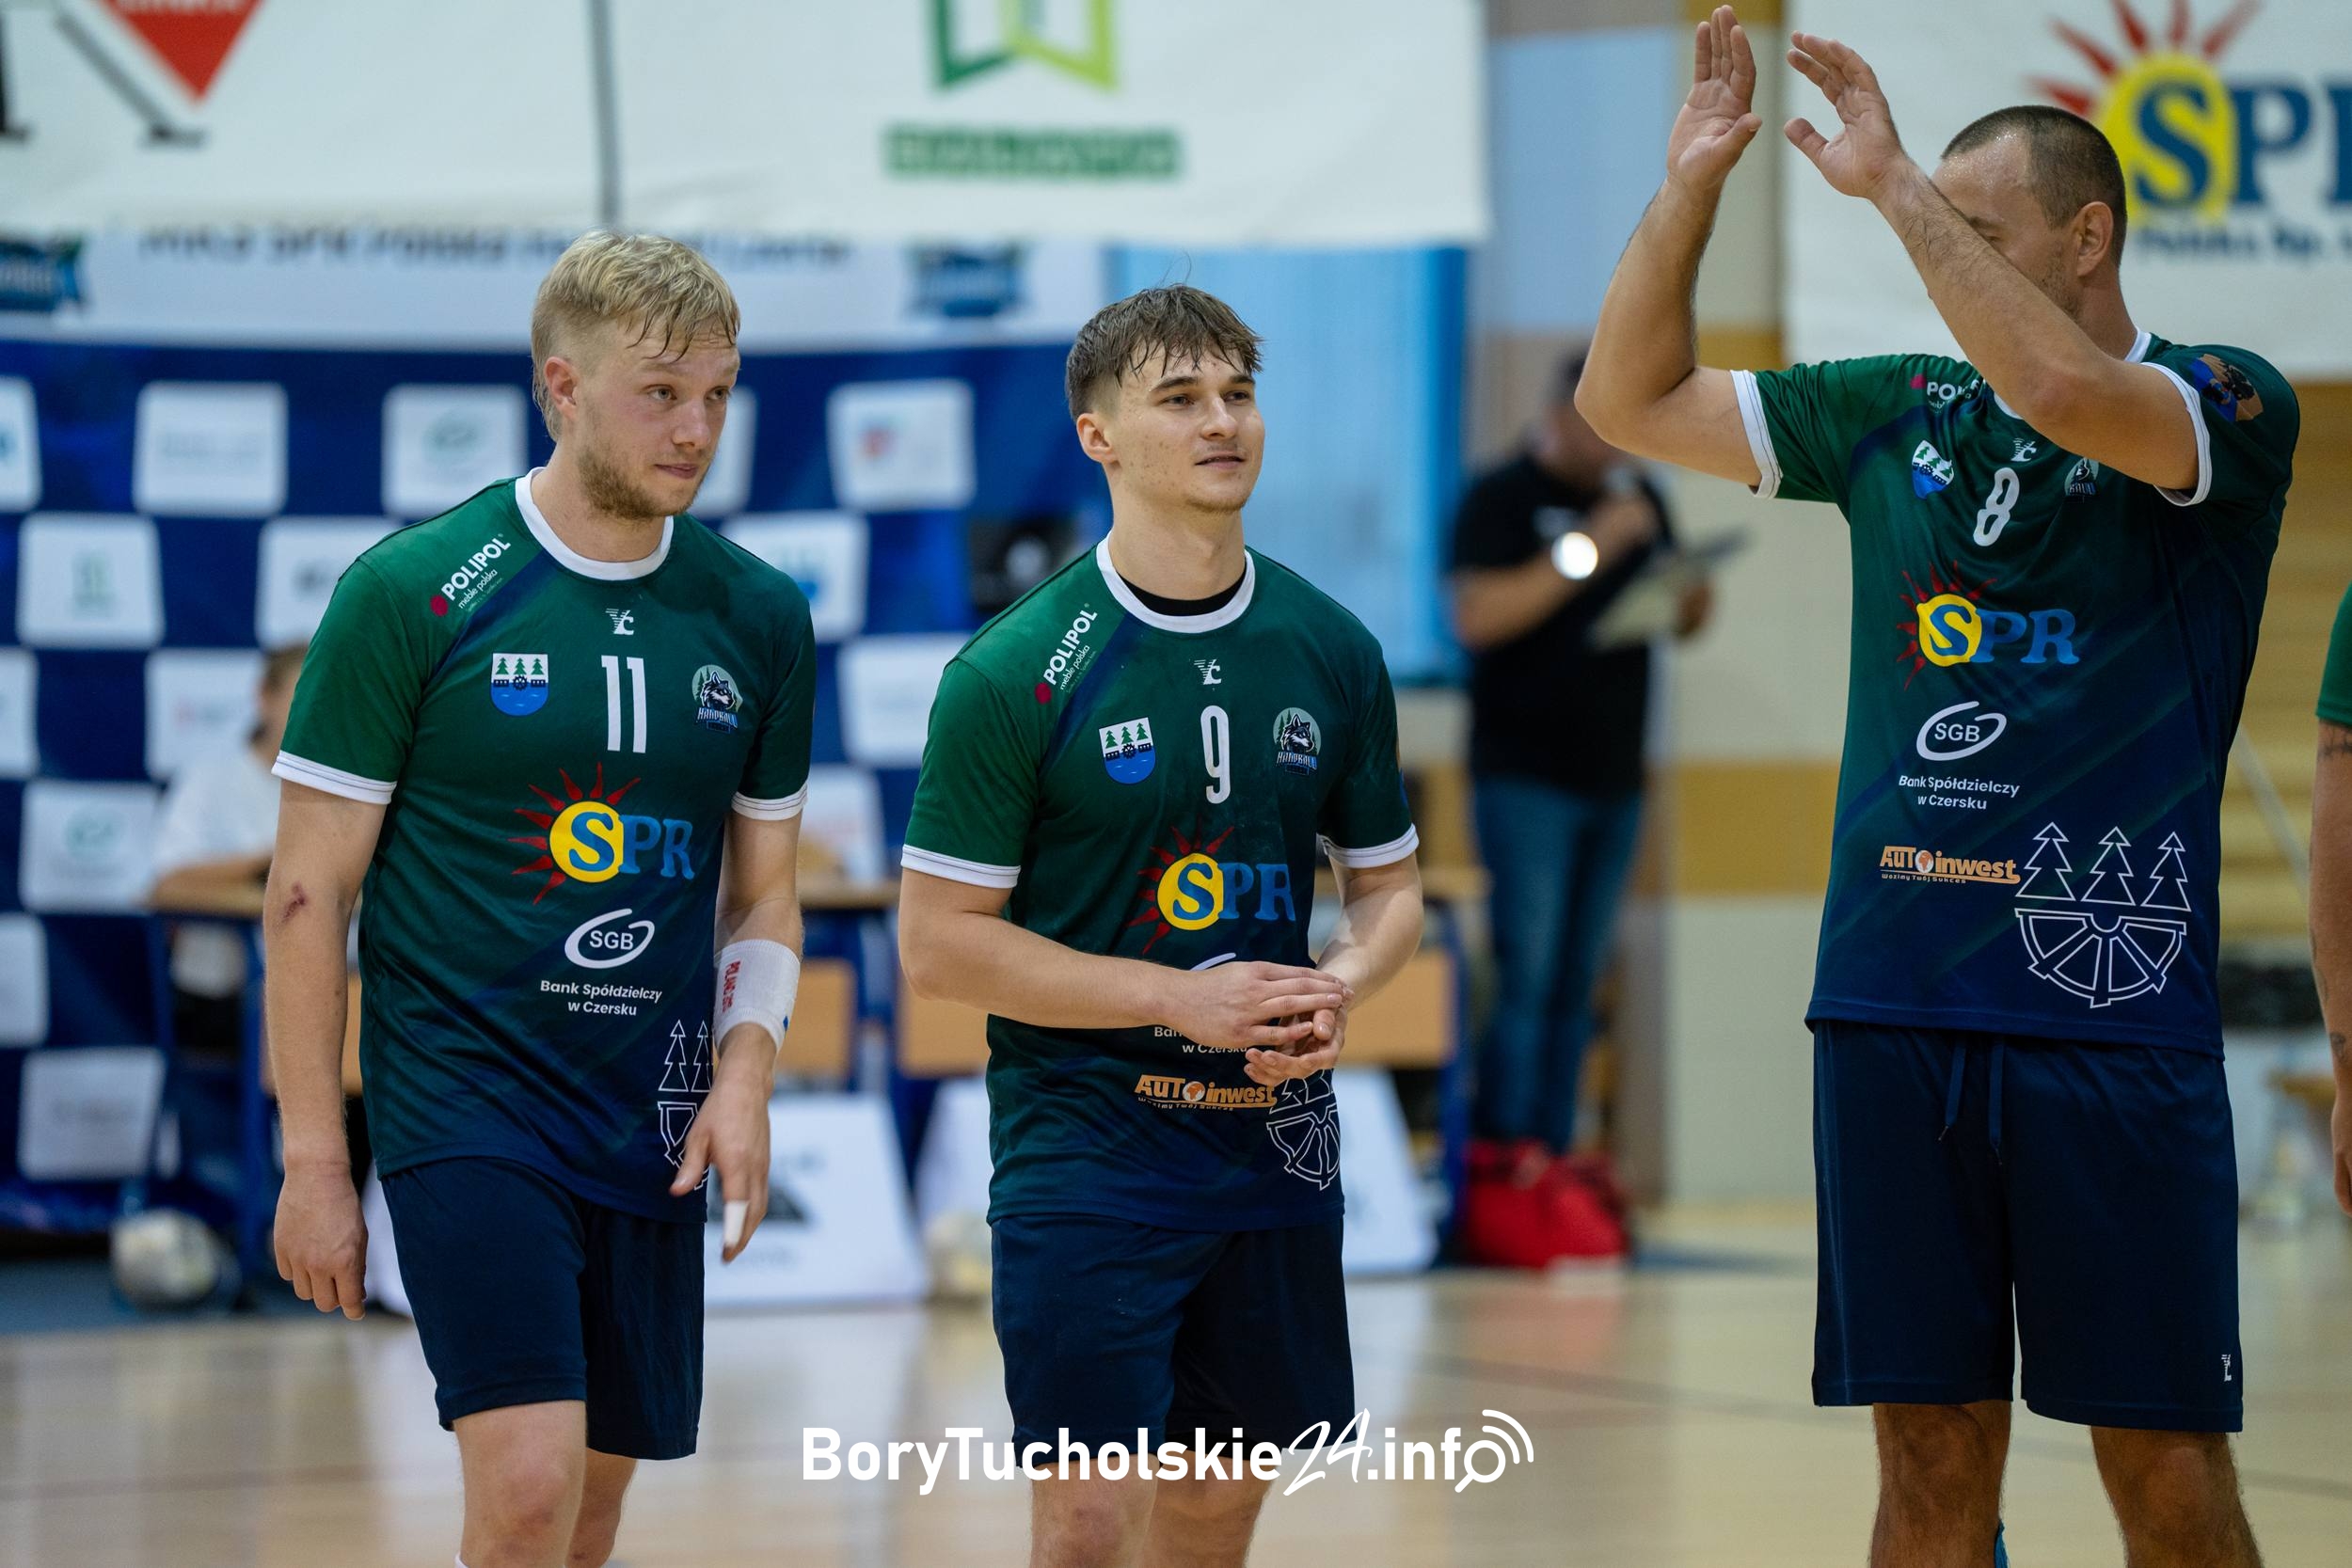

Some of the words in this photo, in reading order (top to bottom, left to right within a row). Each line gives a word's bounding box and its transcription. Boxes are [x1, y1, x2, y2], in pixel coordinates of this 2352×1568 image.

[1973, 467, 2020, 546] 8
[441, 538, 511, 601] POLIPOL
[458, 587, 478, 609] meble
[476, 569, 498, 592] polska
[1043, 610, 1098, 686] POLIPOL
[1929, 604, 2080, 665] SPR
[1059, 668, 1075, 690] meble
[1073, 645, 1090, 670] polska
[601, 655, 647, 753] 11
[1200, 705, 1231, 804] 9
[1934, 722, 1980, 742] SGB
[1899, 775, 1927, 787] Bank
[1928, 776, 2020, 798] Spółdzielczy
[1917, 796, 1927, 805] w
[1929, 794, 1987, 810] Czersku
[568, 811, 695, 879] SPR
[1172, 862, 1296, 921] SPR
[589, 930, 634, 950] SGB
[540, 980, 580, 994] Bank
[582, 984, 662, 1004] Spółdzielczy
[567, 1002, 580, 1011] w
[582, 1001, 637, 1016] Czersku
[1182, 1045, 1195, 1053] w
